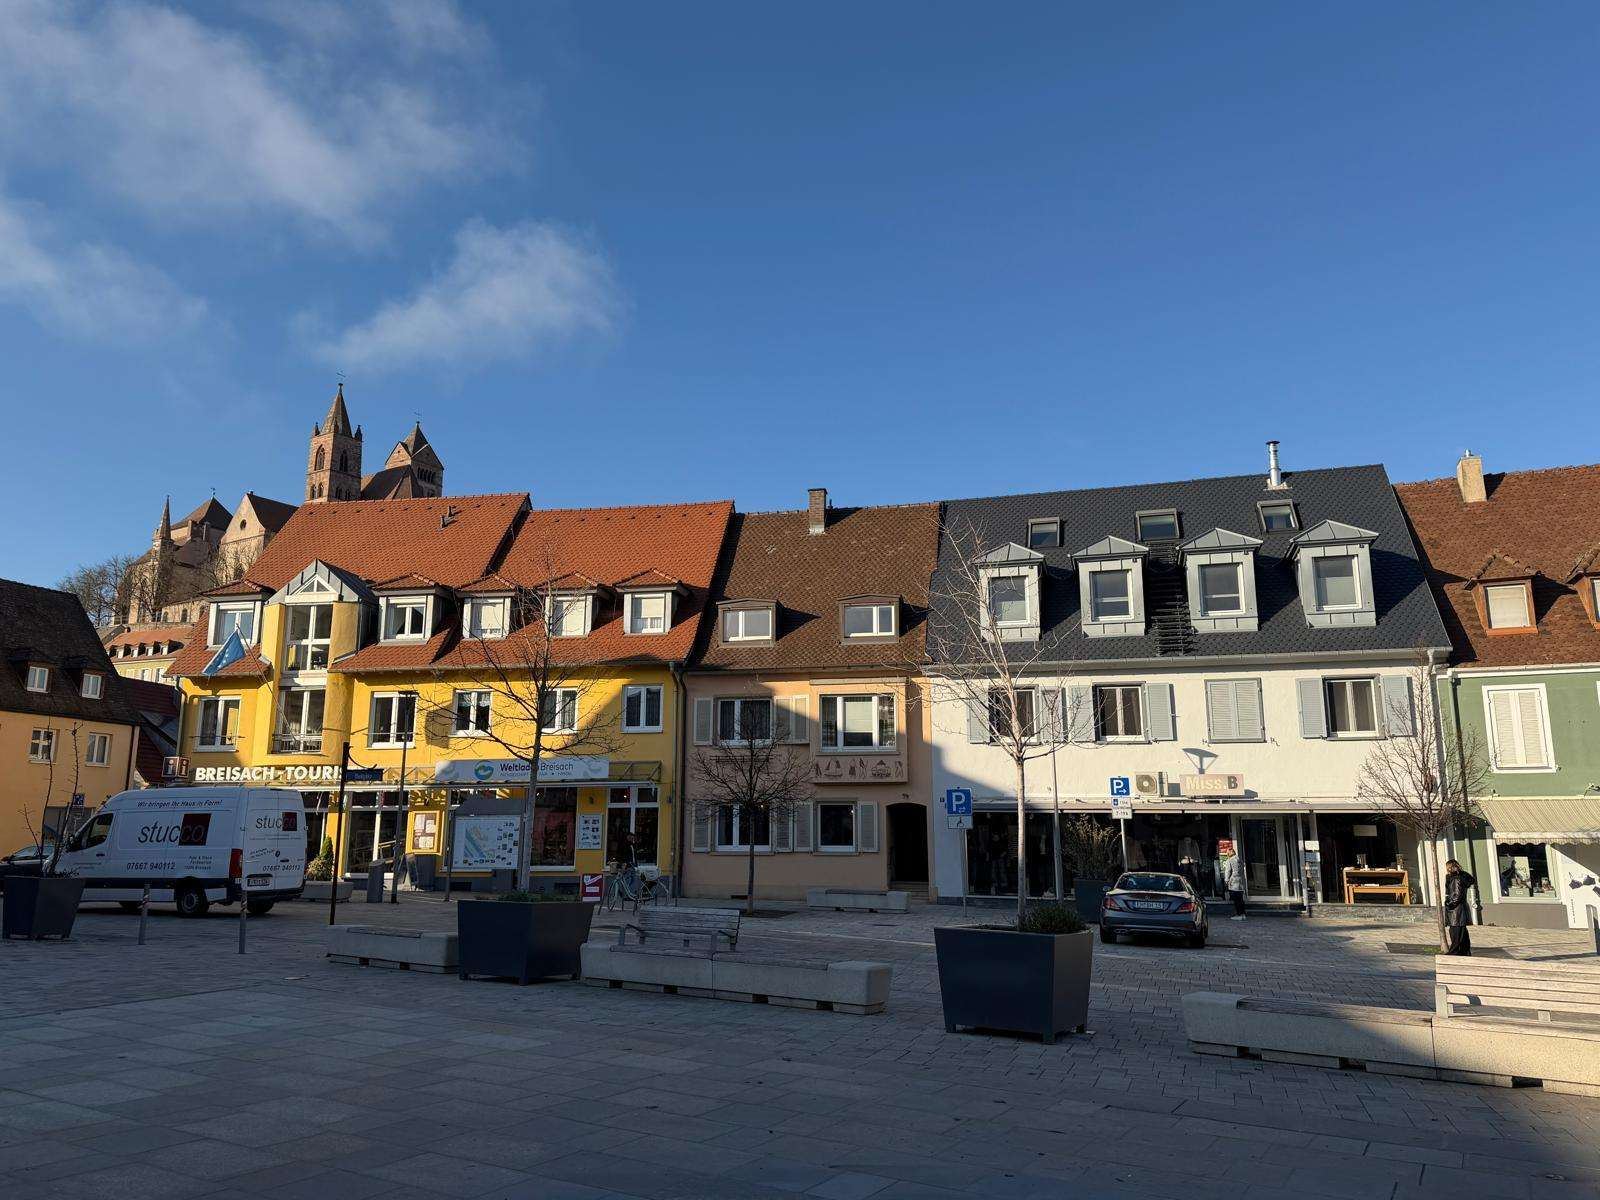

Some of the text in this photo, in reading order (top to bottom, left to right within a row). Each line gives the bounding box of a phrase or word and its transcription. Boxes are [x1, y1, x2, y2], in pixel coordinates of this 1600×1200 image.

[500, 762, 574, 771] Weltlad Breisach
[1113, 780, 1123, 793] P
[952, 792, 966, 812] P
[127, 862, 148, 870] 07667
